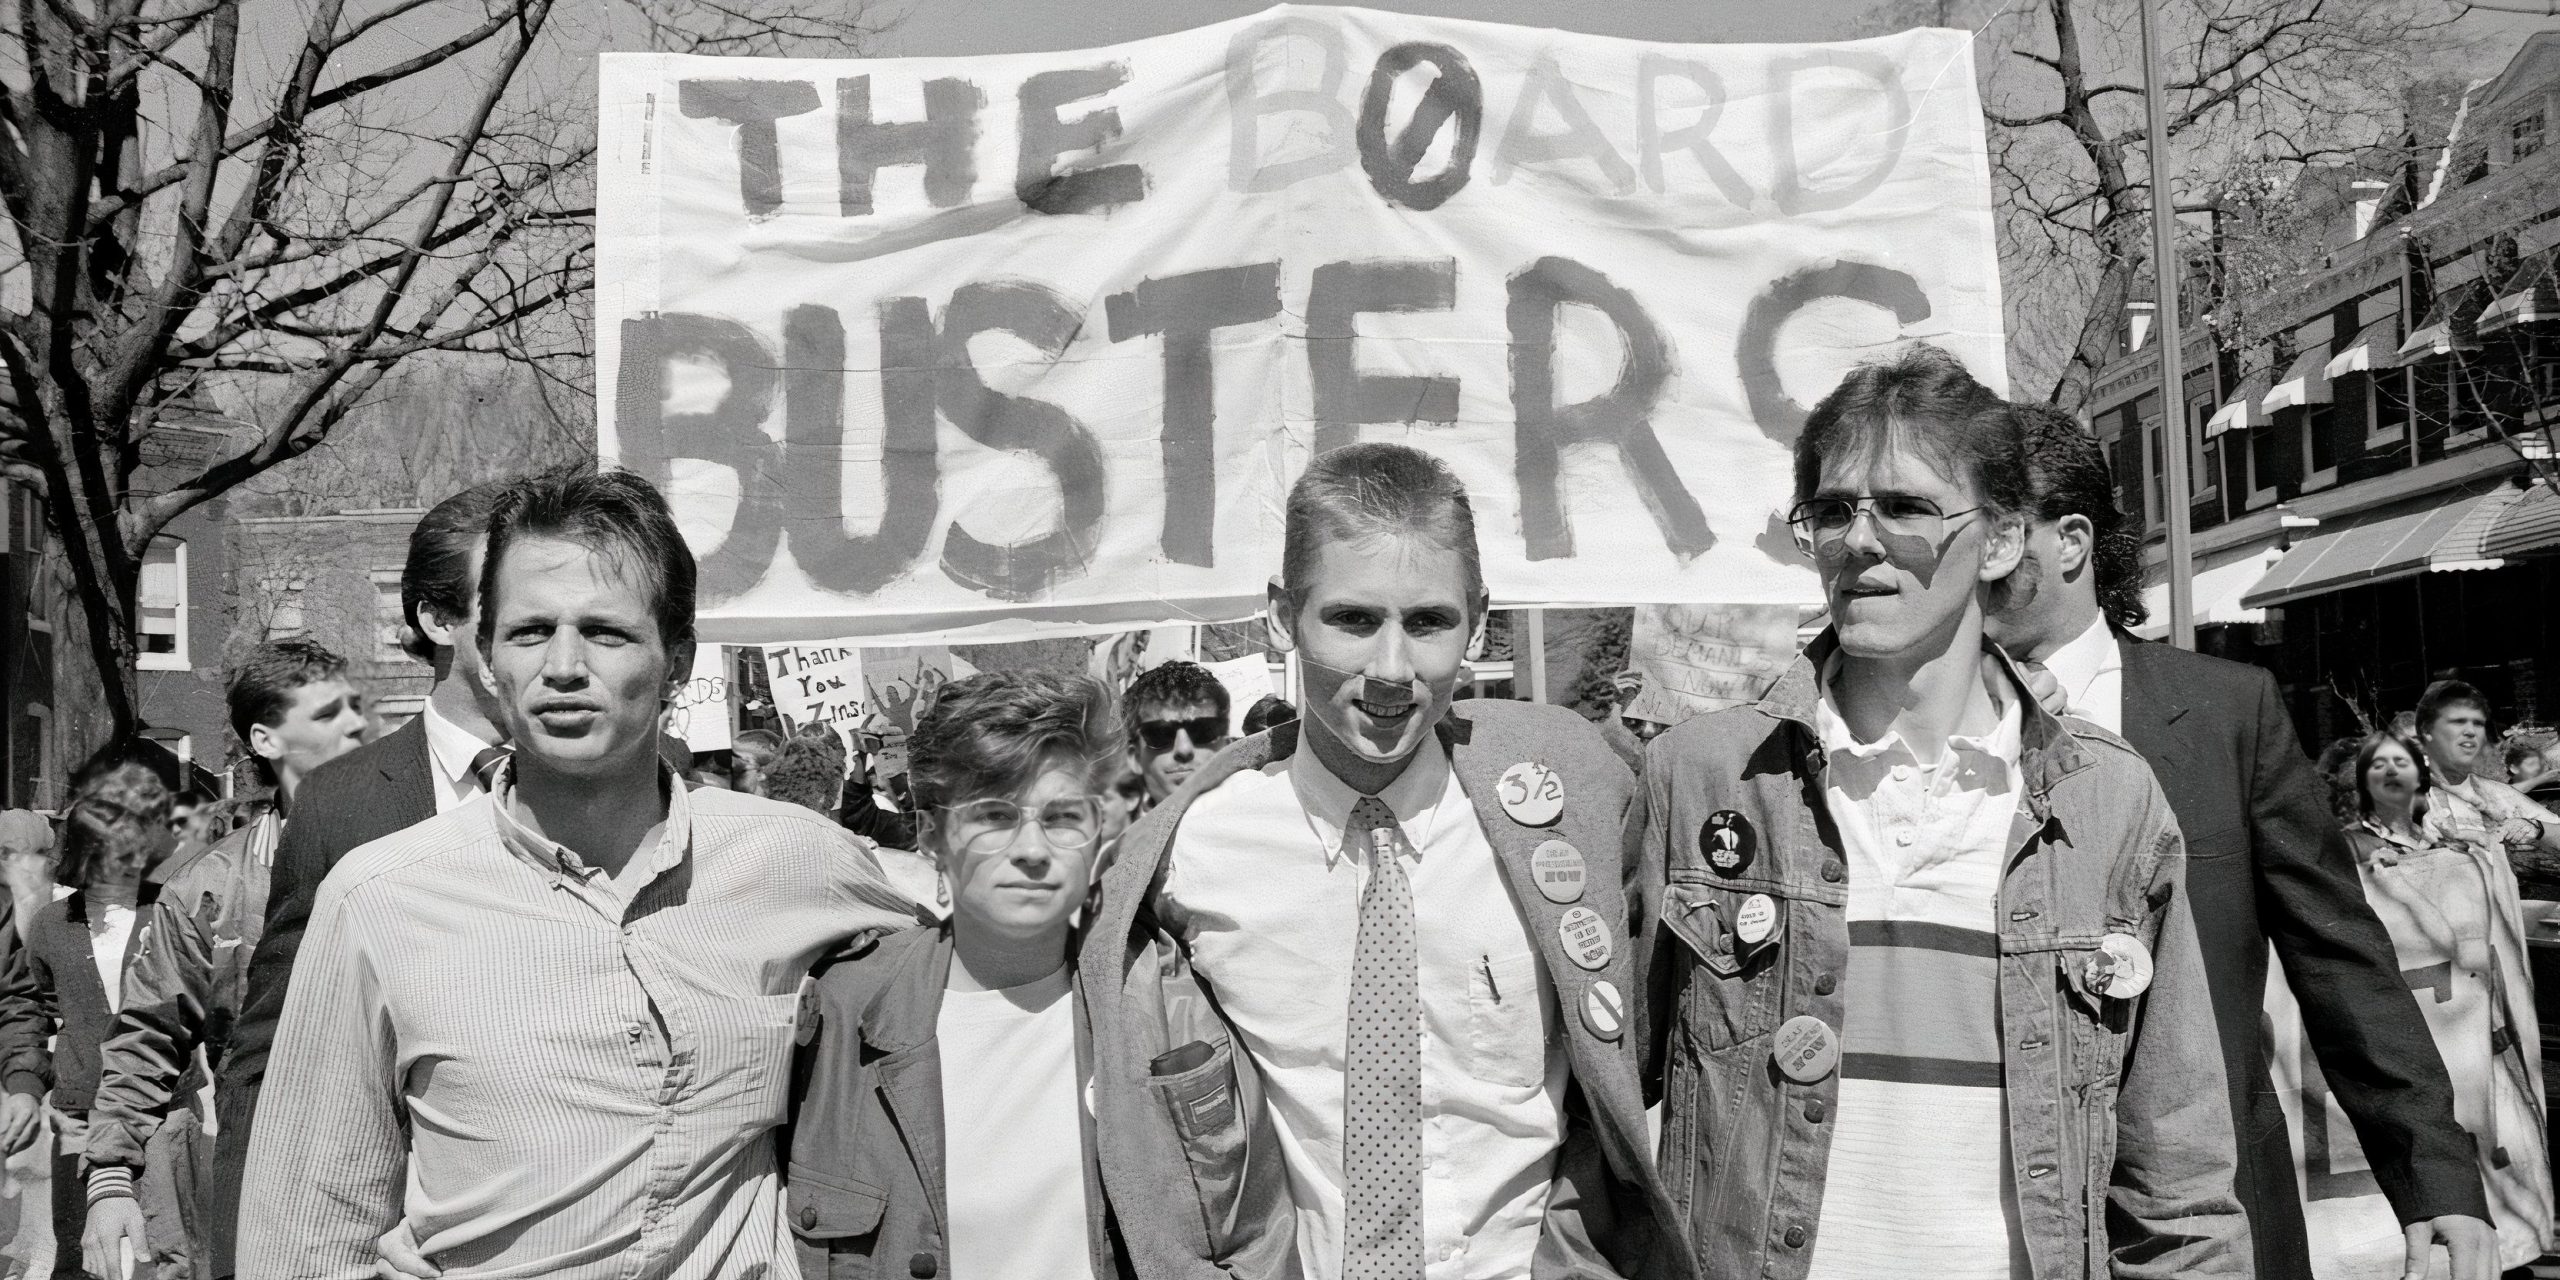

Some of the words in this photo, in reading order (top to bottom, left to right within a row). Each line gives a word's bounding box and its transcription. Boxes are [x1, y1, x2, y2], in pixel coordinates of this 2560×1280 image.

[679, 58, 1149, 221] THE
[768, 647, 852, 679] Thank
[797, 675, 846, 697] You
